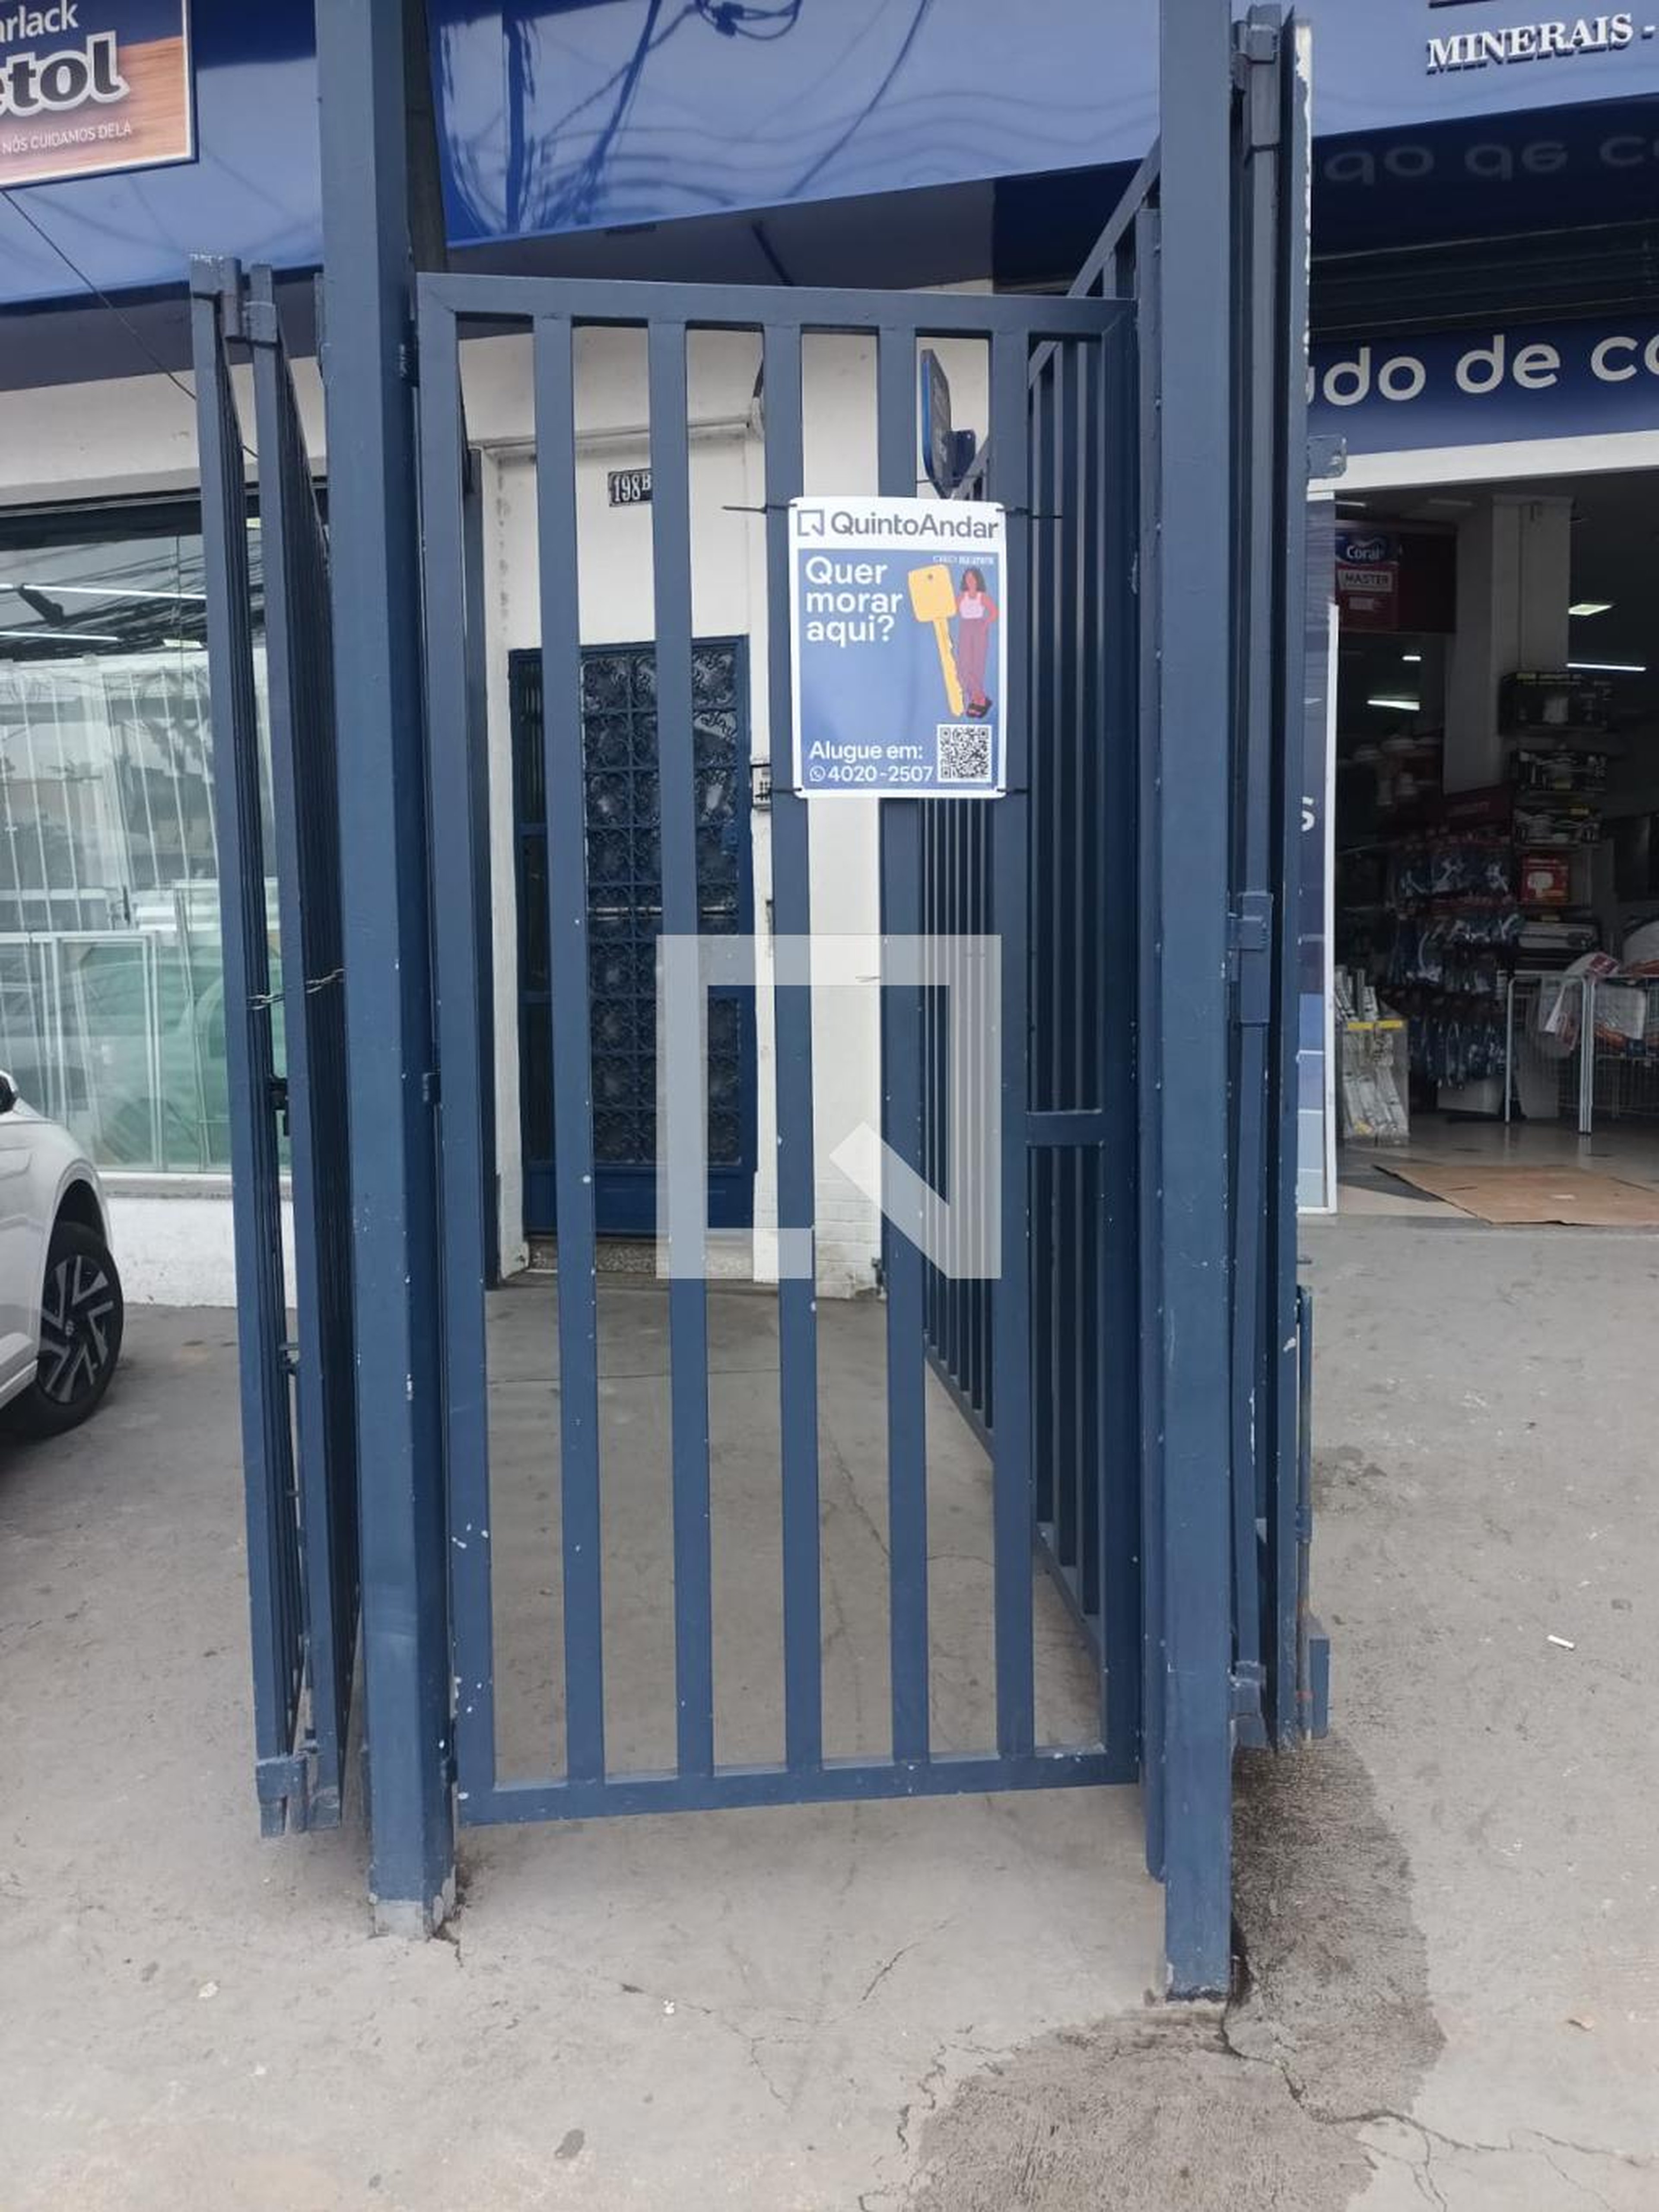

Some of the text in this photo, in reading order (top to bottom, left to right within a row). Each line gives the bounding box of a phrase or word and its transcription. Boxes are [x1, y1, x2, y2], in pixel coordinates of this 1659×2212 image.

[1427, 13, 1634, 71] MINERAIS
[0, 30, 130, 117] tol
[2, 119, 132, 154] NÓS CUIDAMOS DELA
[1455, 334, 1561, 394] de
[831, 511, 999, 539] QuintoAndar
[1346, 544, 1380, 560] Coral
[806, 556, 888, 585] Quer
[1344, 573, 1389, 584] MASTER
[806, 592, 903, 613] morar
[806, 615, 895, 647] aqui?
[810, 741, 923, 763] Alugue em:
[828, 766, 933, 783] 4020-2507
